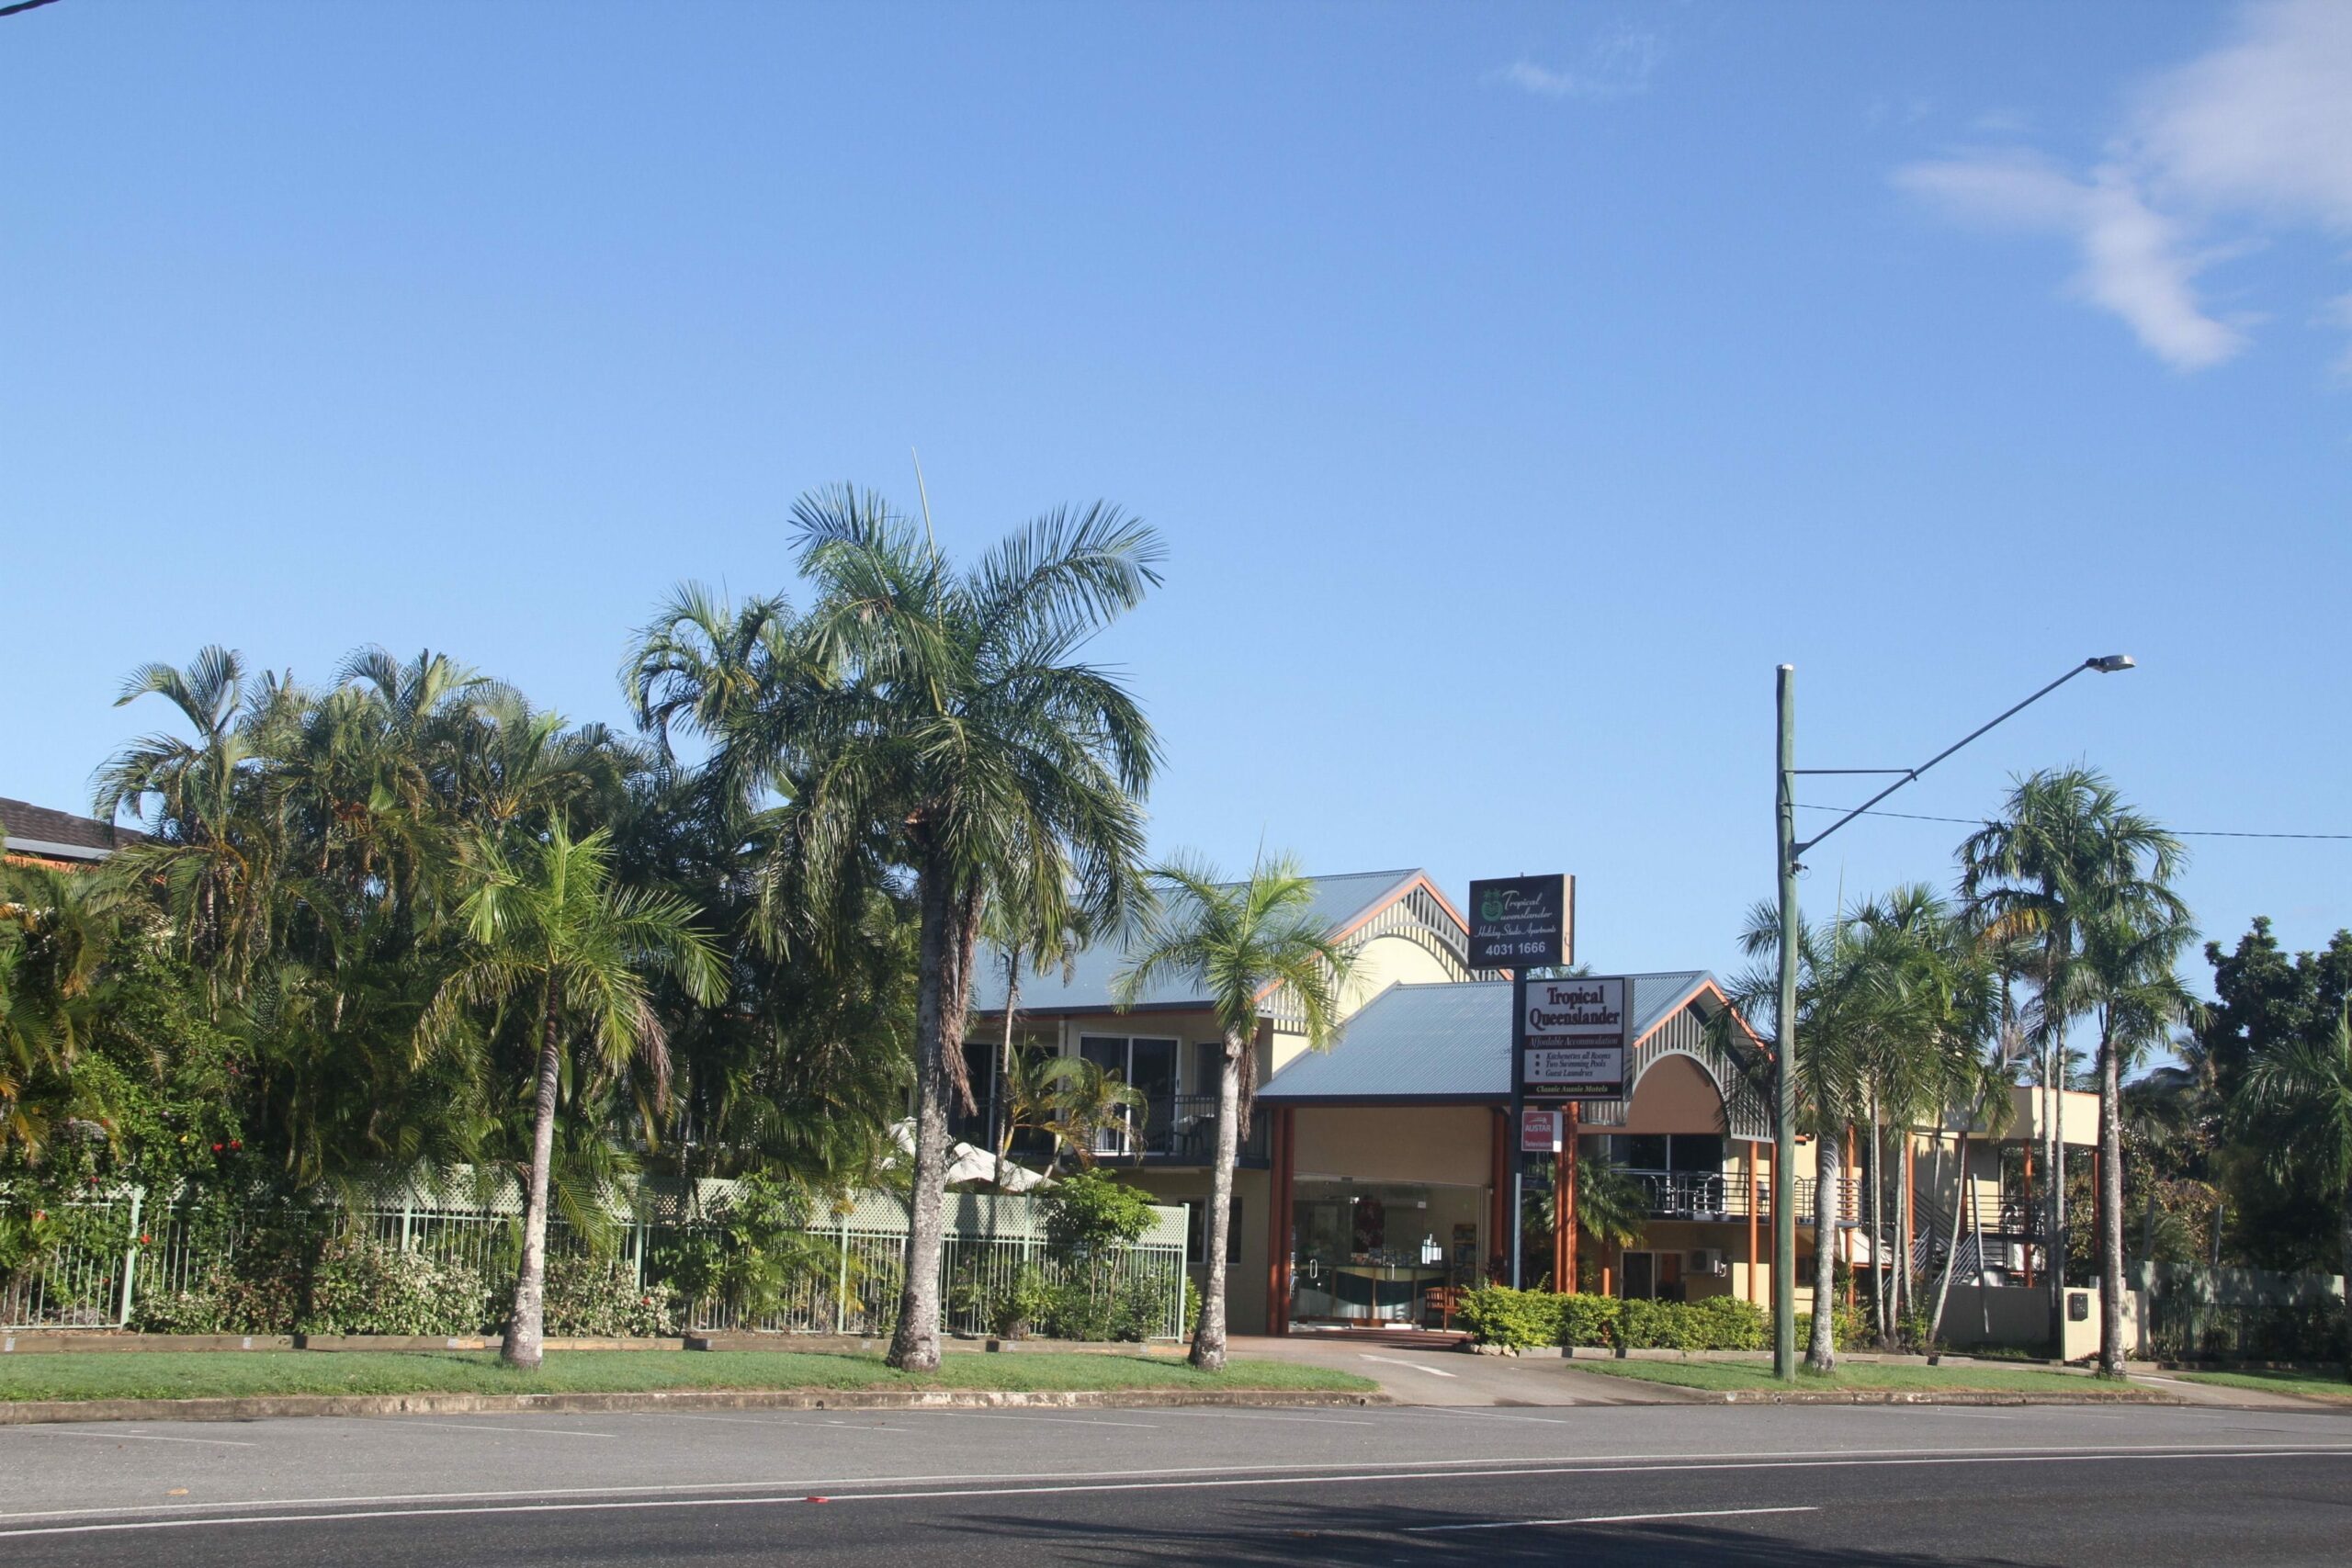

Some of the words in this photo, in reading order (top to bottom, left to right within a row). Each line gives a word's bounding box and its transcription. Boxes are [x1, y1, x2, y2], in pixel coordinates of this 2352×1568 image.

[1502, 890, 1543, 910] Tropical
[1486, 943, 1512, 956] 4031
[1519, 942, 1545, 954] 1666
[1547, 985, 1604, 1010] Tropical
[1530, 1006, 1620, 1031] Queenslander
